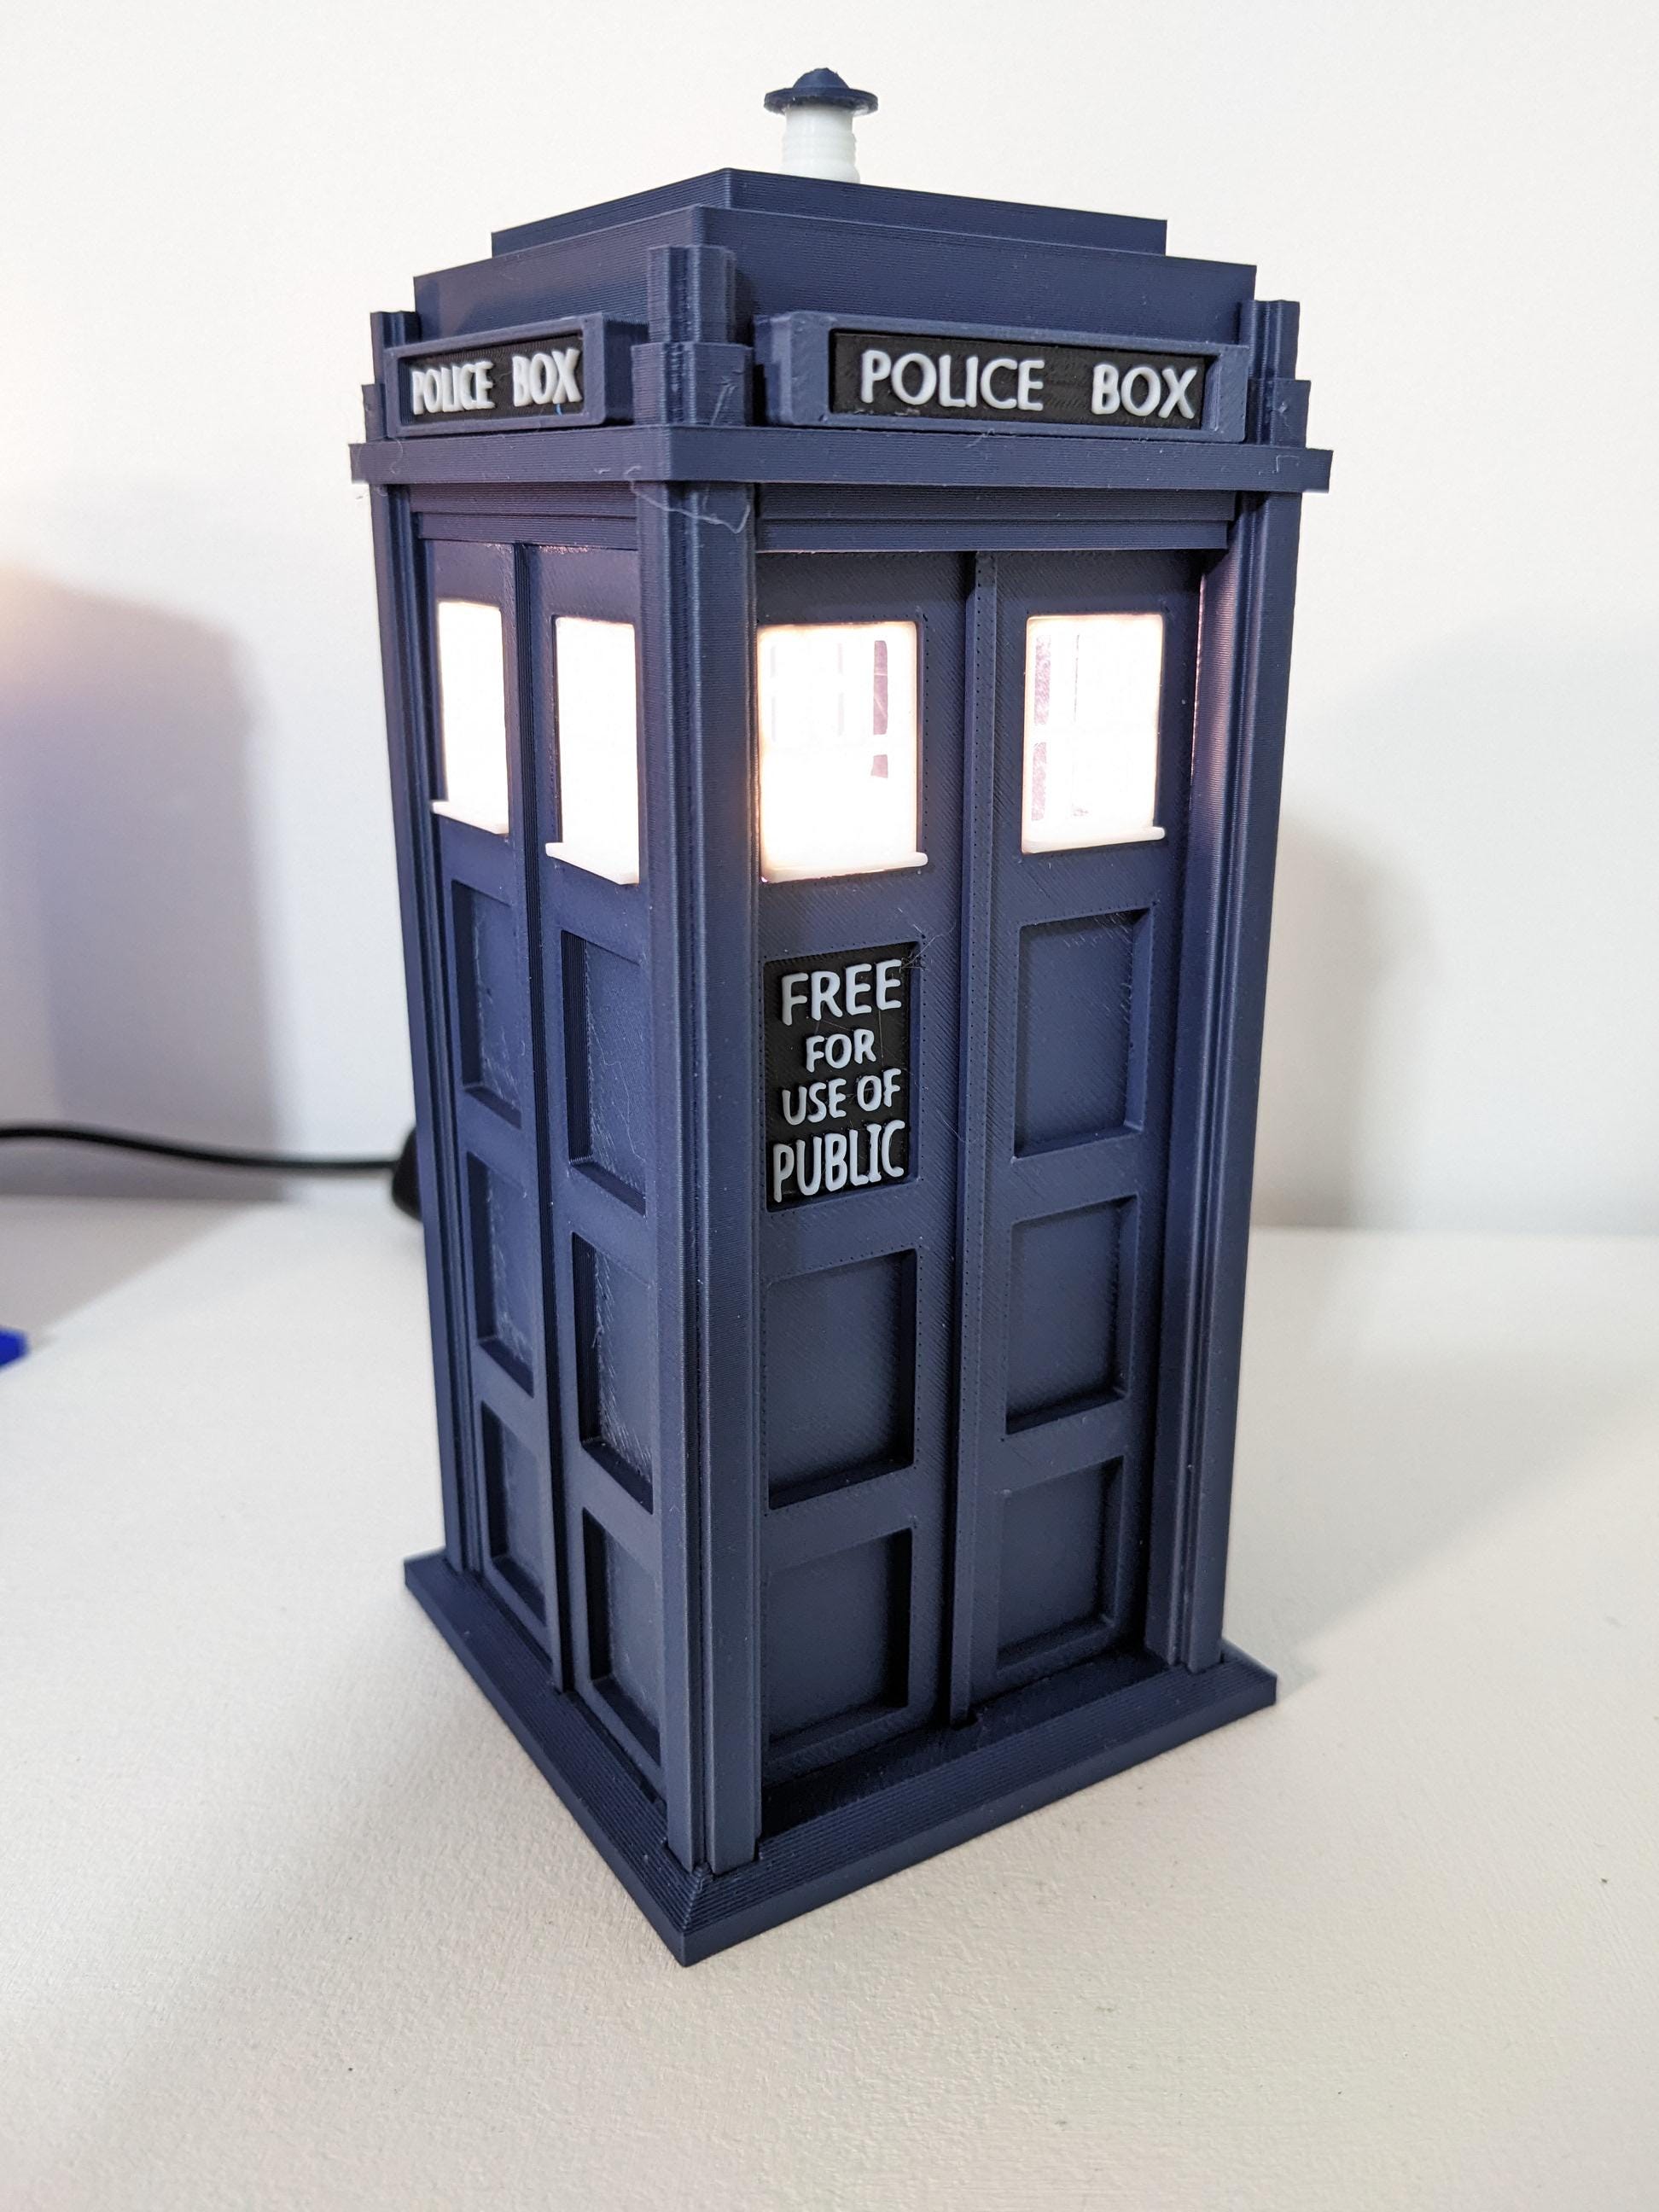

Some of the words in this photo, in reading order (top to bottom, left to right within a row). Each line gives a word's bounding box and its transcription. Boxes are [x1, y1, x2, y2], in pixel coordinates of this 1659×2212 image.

[411, 360, 496, 416] POLICE
[512, 346, 583, 408] BOX
[860, 349, 1045, 411] POLICE
[1091, 363, 1197, 419] BOX
[781, 958, 902, 1026] FREE
[806, 1027, 877, 1073] FOR
[782, 1078, 847, 1126] USE
[857, 1068, 902, 1112] OF
[773, 1120, 905, 1203] PUBLIC
